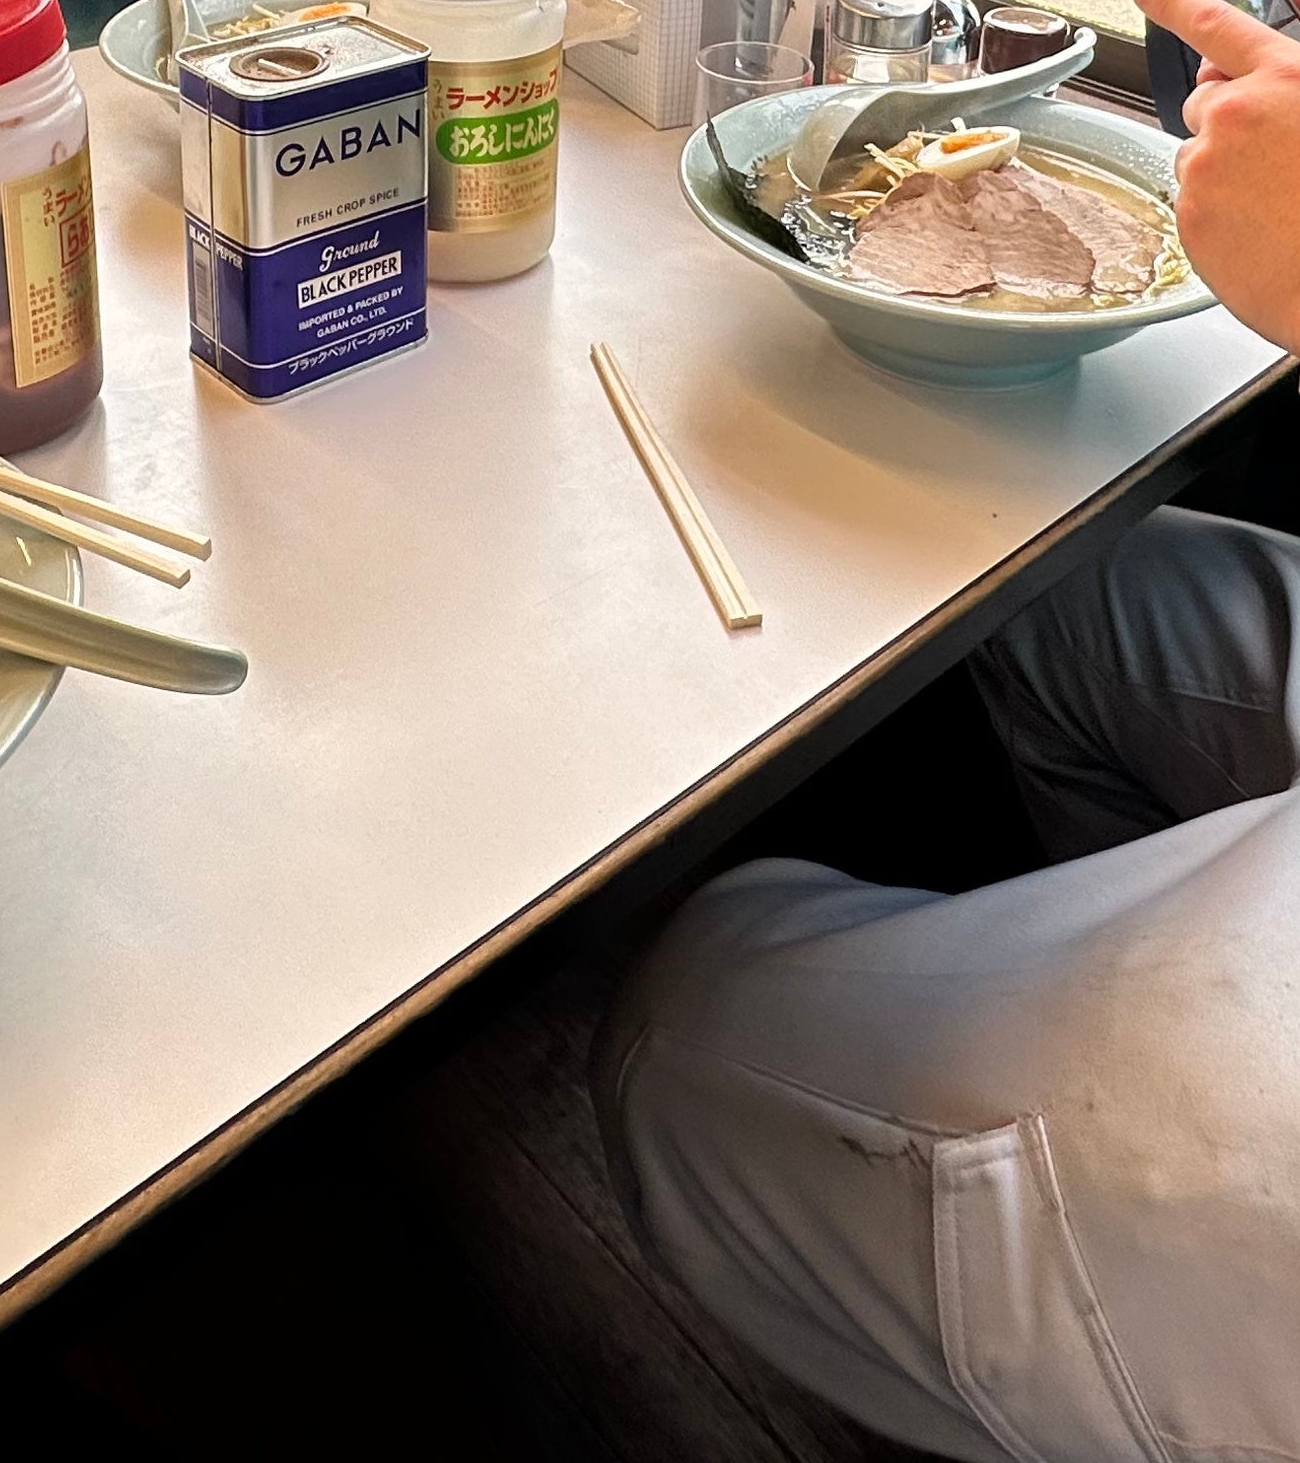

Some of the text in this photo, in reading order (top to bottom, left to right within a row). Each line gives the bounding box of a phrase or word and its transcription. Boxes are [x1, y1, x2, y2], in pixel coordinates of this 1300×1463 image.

[446, 68, 558, 110] ラーメンショップ
[275, 108, 421, 177] GABAN
[449, 107, 554, 158] おろしにんにく
[296, 188, 400, 228] FRESH CROP SPICE
[188, 223, 244, 271] BLACK PEPPER
[318, 230, 380, 272] Ground
[301, 256, 398, 303] BLACK PEPPER
[299, 286, 404, 331] IMPORTED & PACKED BY
[316, 320, 349, 338] GABAN
[288, 317, 414, 375] ブラックペッパーグラウンド
